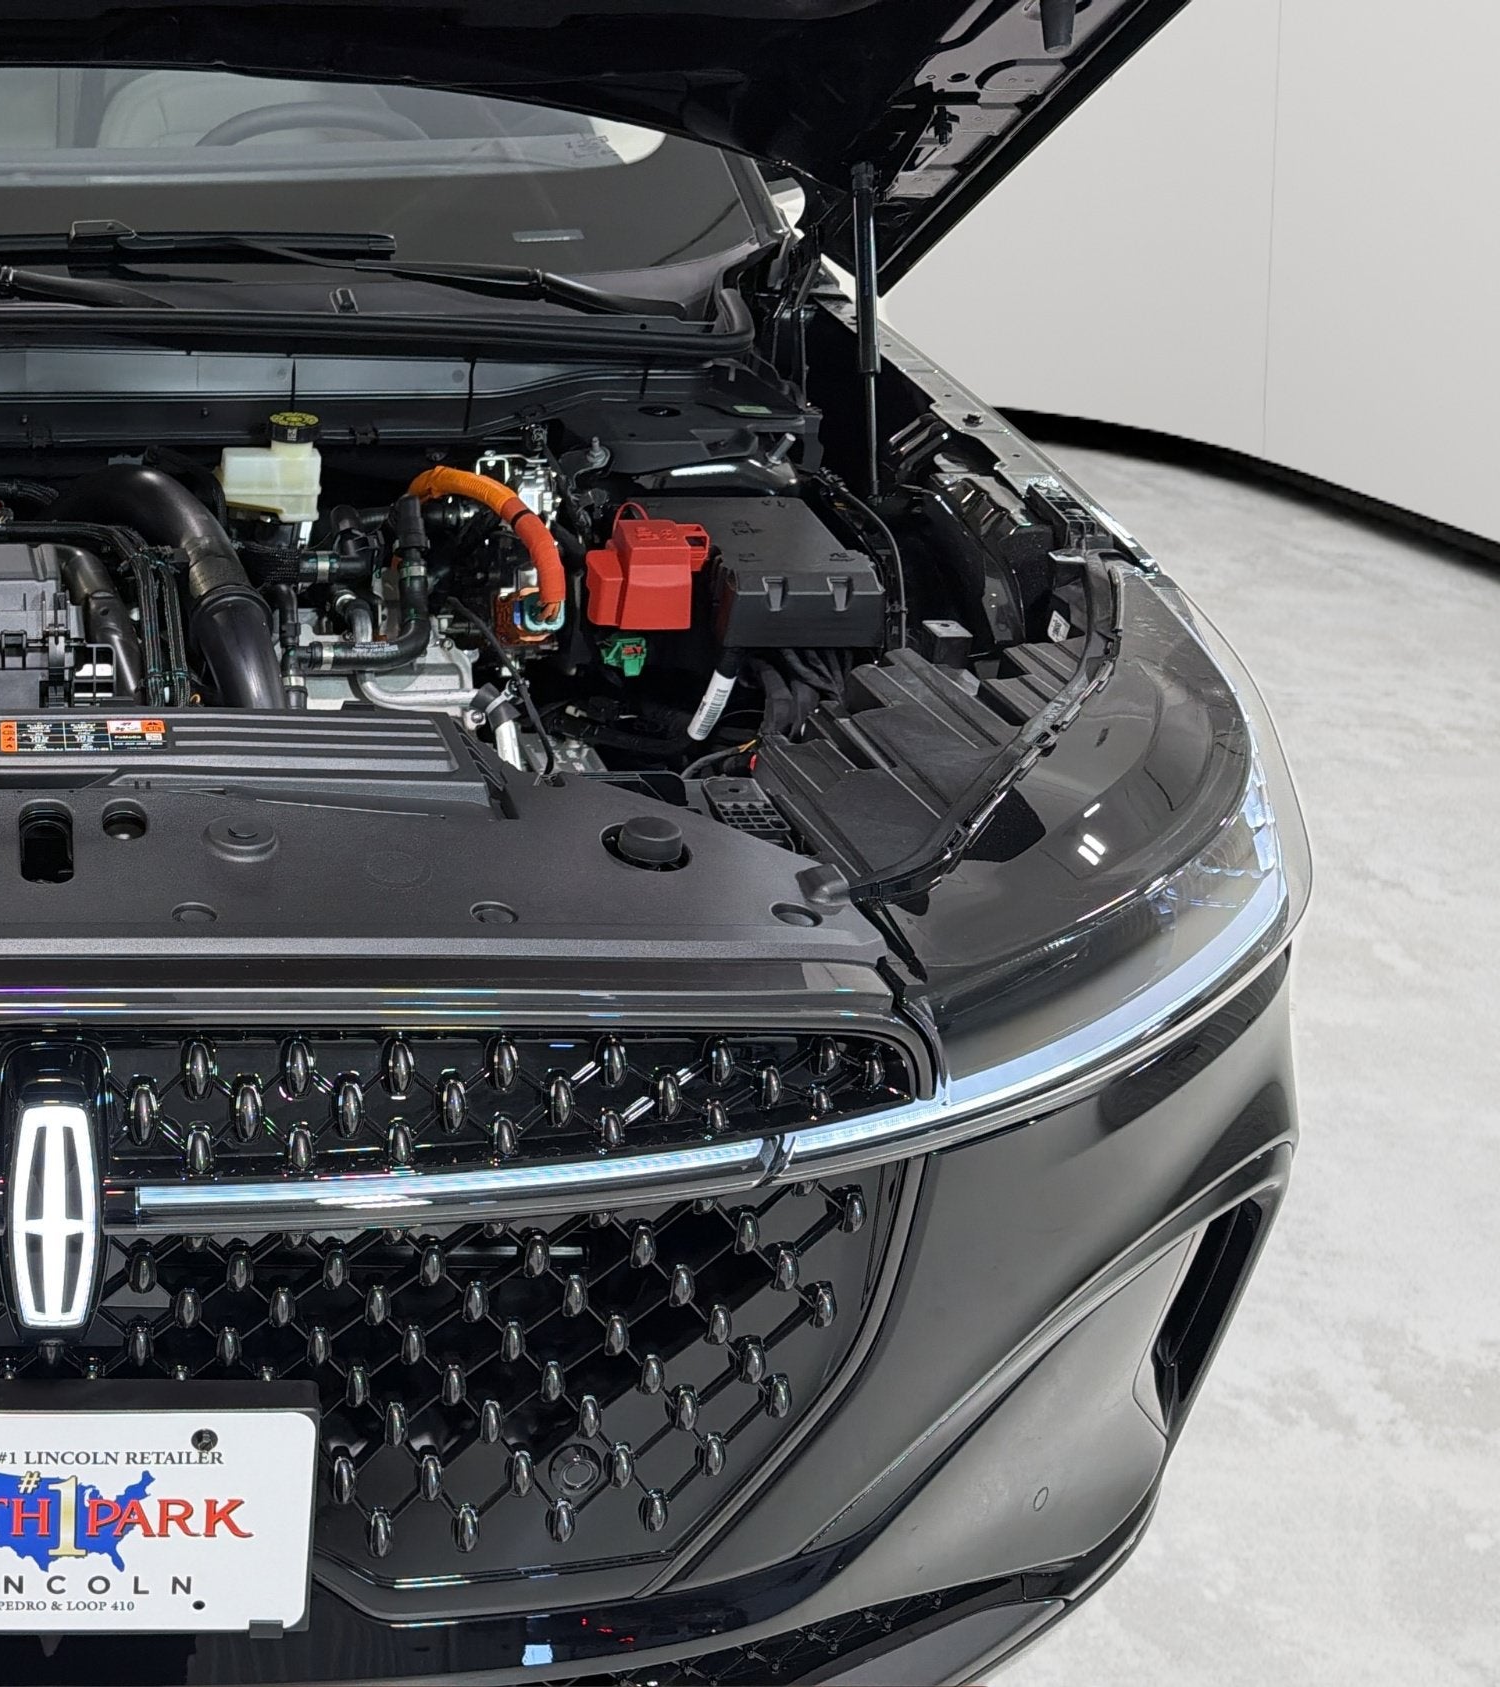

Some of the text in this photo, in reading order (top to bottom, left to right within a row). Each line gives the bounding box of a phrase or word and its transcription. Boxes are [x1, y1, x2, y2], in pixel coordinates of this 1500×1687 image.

[25, 1451, 120, 1466] LINCOLN
[125, 1451, 224, 1466] RETAILER
[87, 1499, 254, 1539] PARK
[51, 1601, 62, 1611] &
[66, 1601, 106, 1611] LOOP
[110, 1601, 135, 1611] 410
